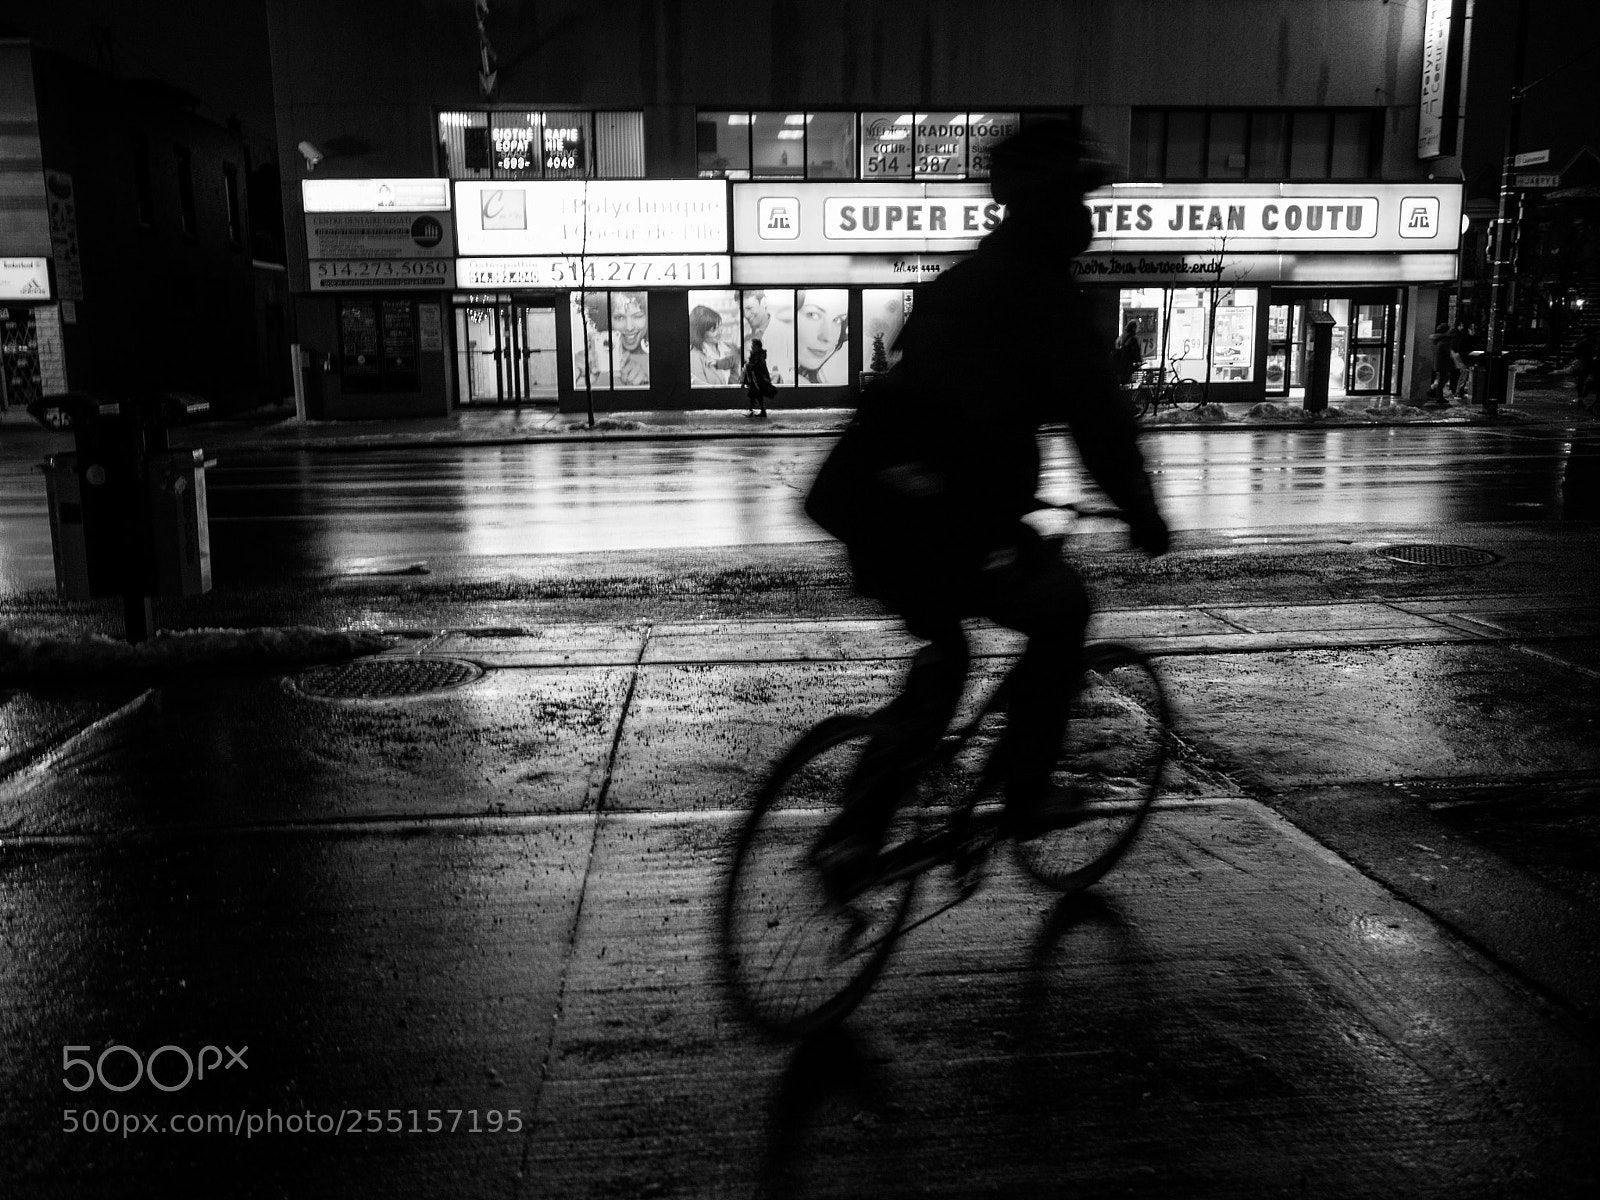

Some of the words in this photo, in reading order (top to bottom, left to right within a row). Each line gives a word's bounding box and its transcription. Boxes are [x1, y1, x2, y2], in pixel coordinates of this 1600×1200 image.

[868, 157, 899, 172] 514
[919, 157, 951, 172] 387
[839, 204, 947, 232] SUPER
[1167, 204, 1246, 231] JEAN
[1261, 204, 1364, 231] COUTU
[551, 261, 721, 282] 514.277.4111
